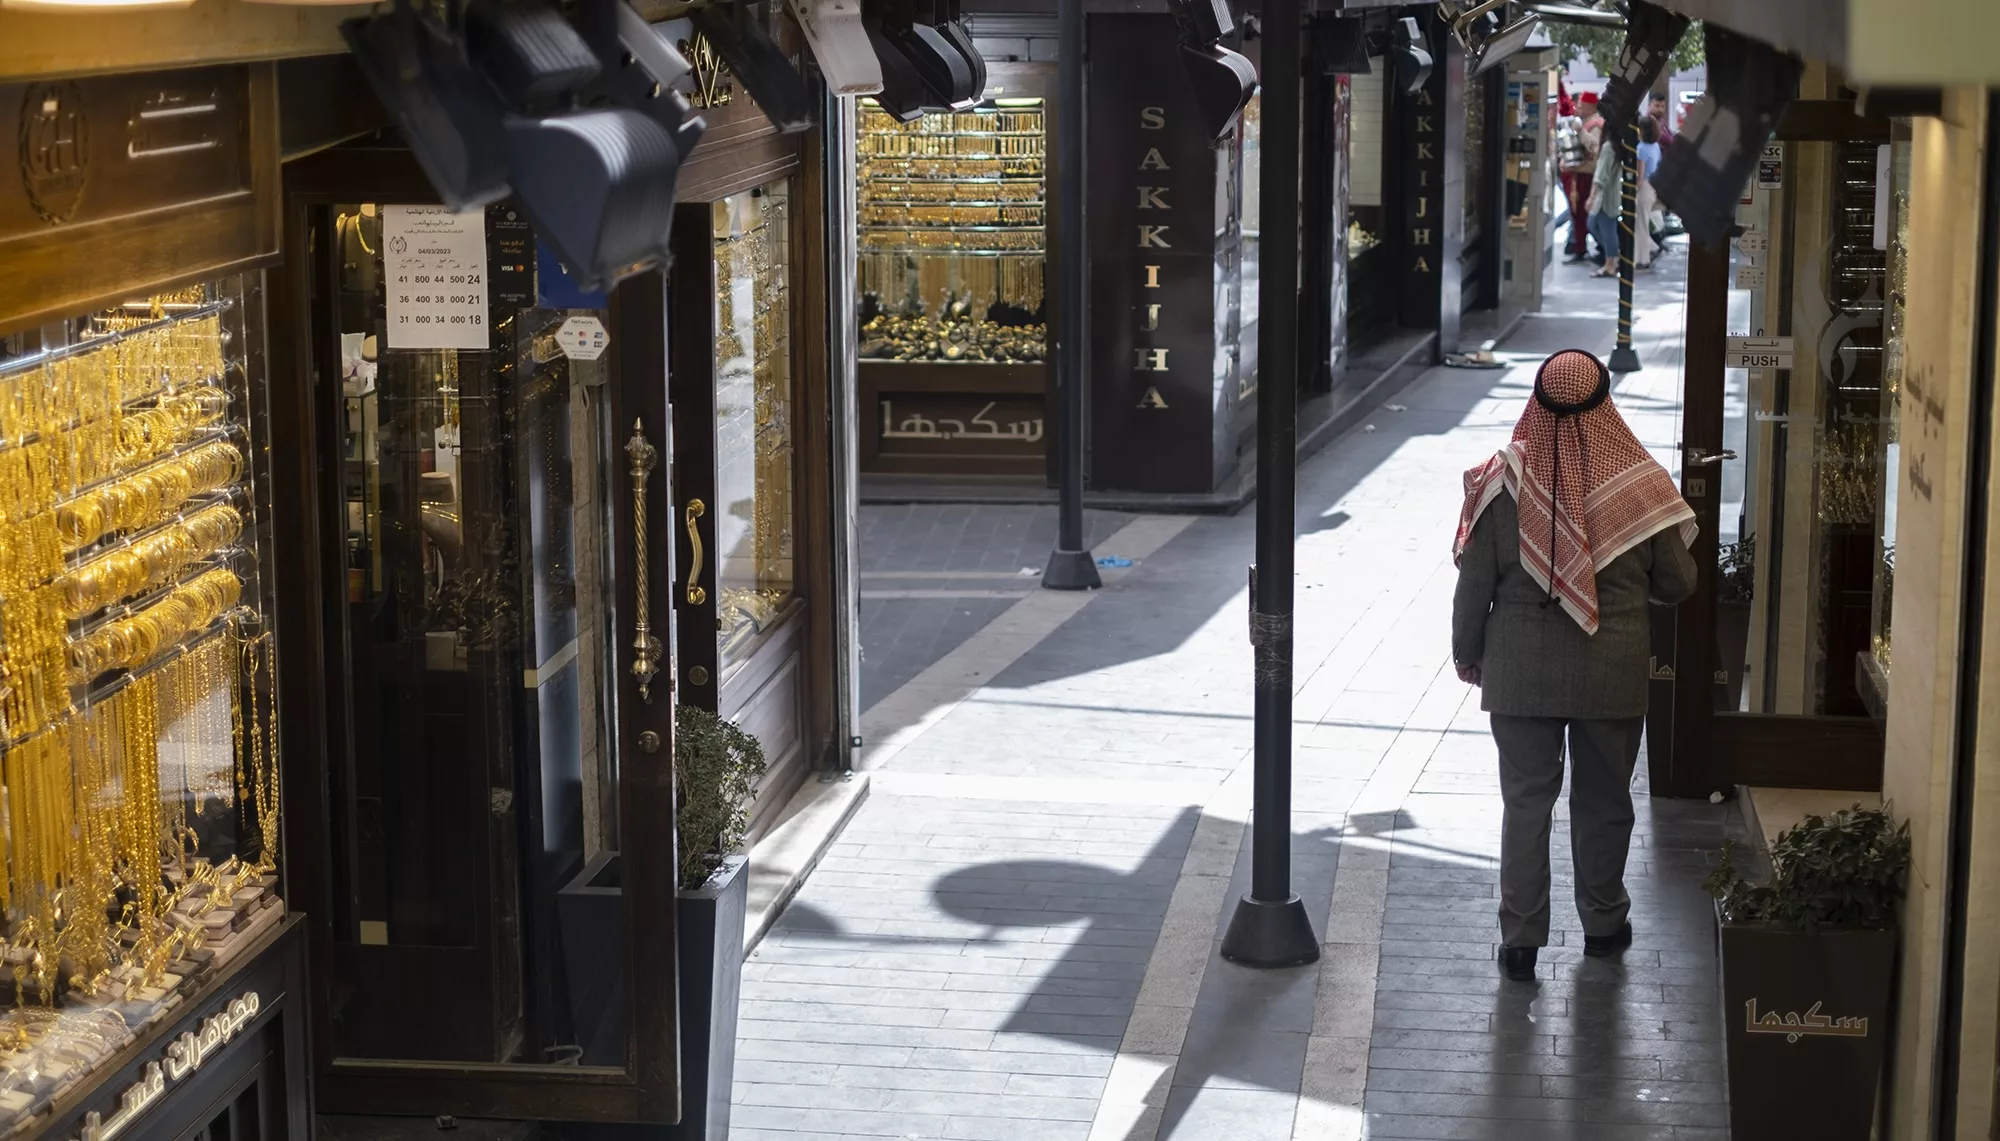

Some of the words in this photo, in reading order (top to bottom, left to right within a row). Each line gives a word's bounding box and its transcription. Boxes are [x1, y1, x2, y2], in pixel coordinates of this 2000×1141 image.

[1412, 88, 1434, 273] AKKIJHA
[1133, 106, 1172, 409] SAKKIJHA
[398, 275, 408, 283] 41
[415, 275, 430, 283] 800
[434, 275, 444, 283] 44
[450, 275, 465, 283] 500
[467, 274, 480, 285] 24
[399, 295, 409, 303] 36
[415, 295, 430, 303] 400
[435, 295, 445, 303] 38
[450, 295, 465, 303] 000
[467, 294, 480, 305] 21
[399, 315, 409, 324] 31
[415, 315, 431, 324] 000
[435, 315, 445, 324] 34
[450, 315, 466, 324] 000
[468, 314, 481, 325] 18
[1741, 355, 1779, 367] PUSH
[880, 399, 1044, 442] سكجها
[162, 990, 260, 1081] مجوهرات
[1745, 997, 1869, 1044] سكجها
